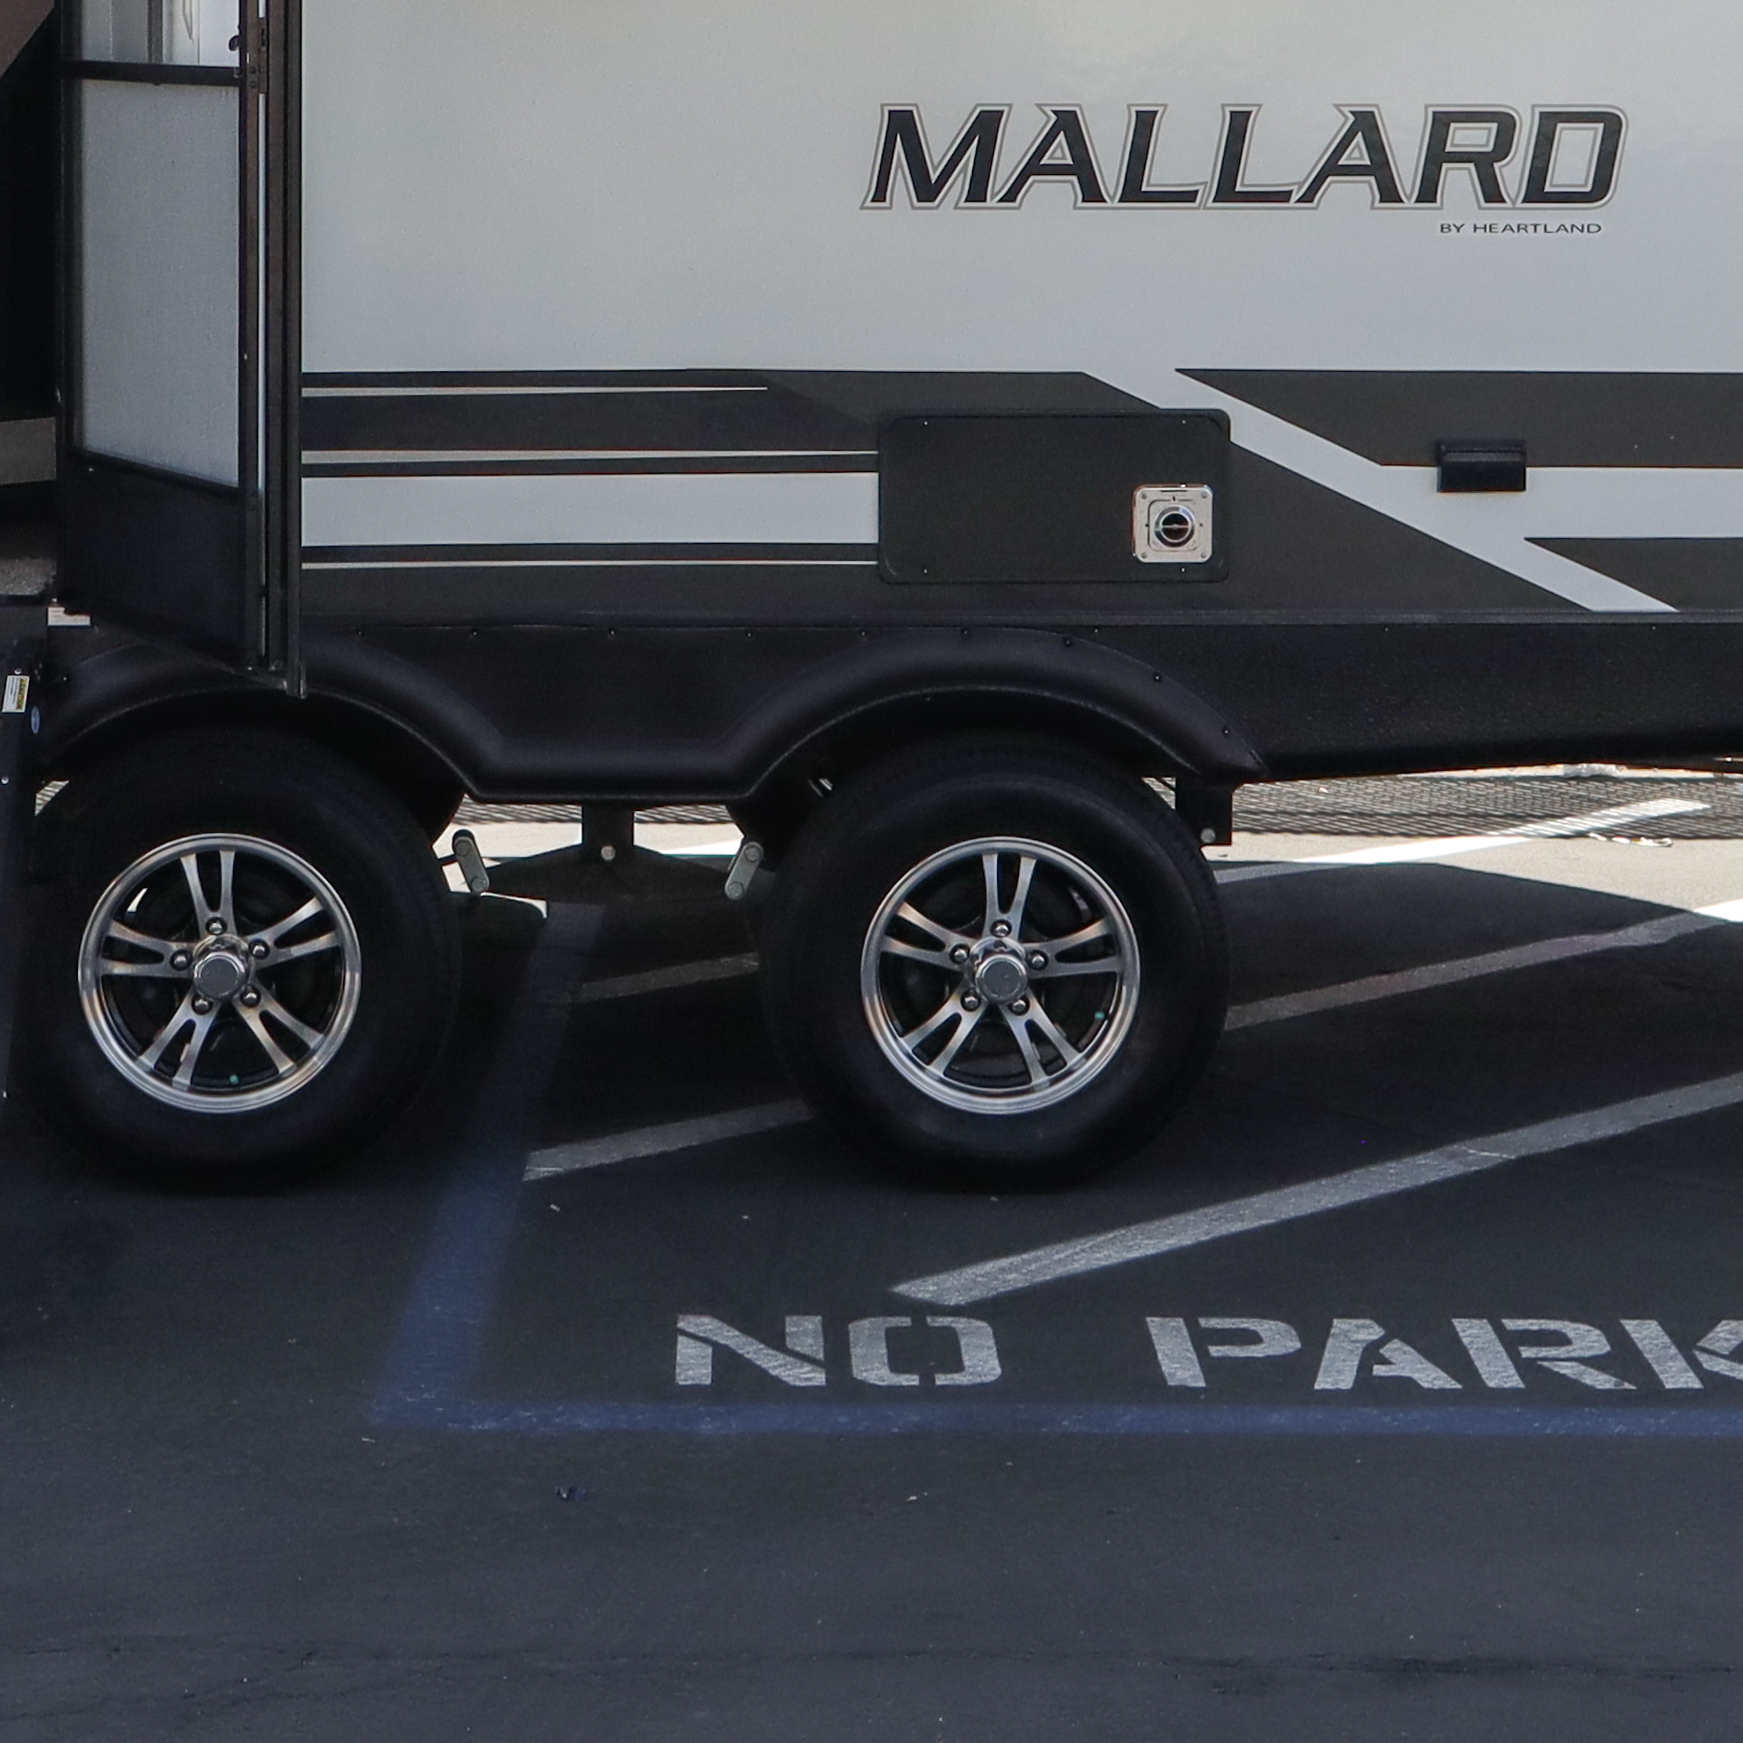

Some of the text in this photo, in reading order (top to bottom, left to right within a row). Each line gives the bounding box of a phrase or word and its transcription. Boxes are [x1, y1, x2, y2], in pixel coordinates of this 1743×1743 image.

[859, 102, 1630, 211] MALLARD
[1440, 223, 1602, 234] BY HEARTLAND
[675, 1315, 1002, 1387] NO
